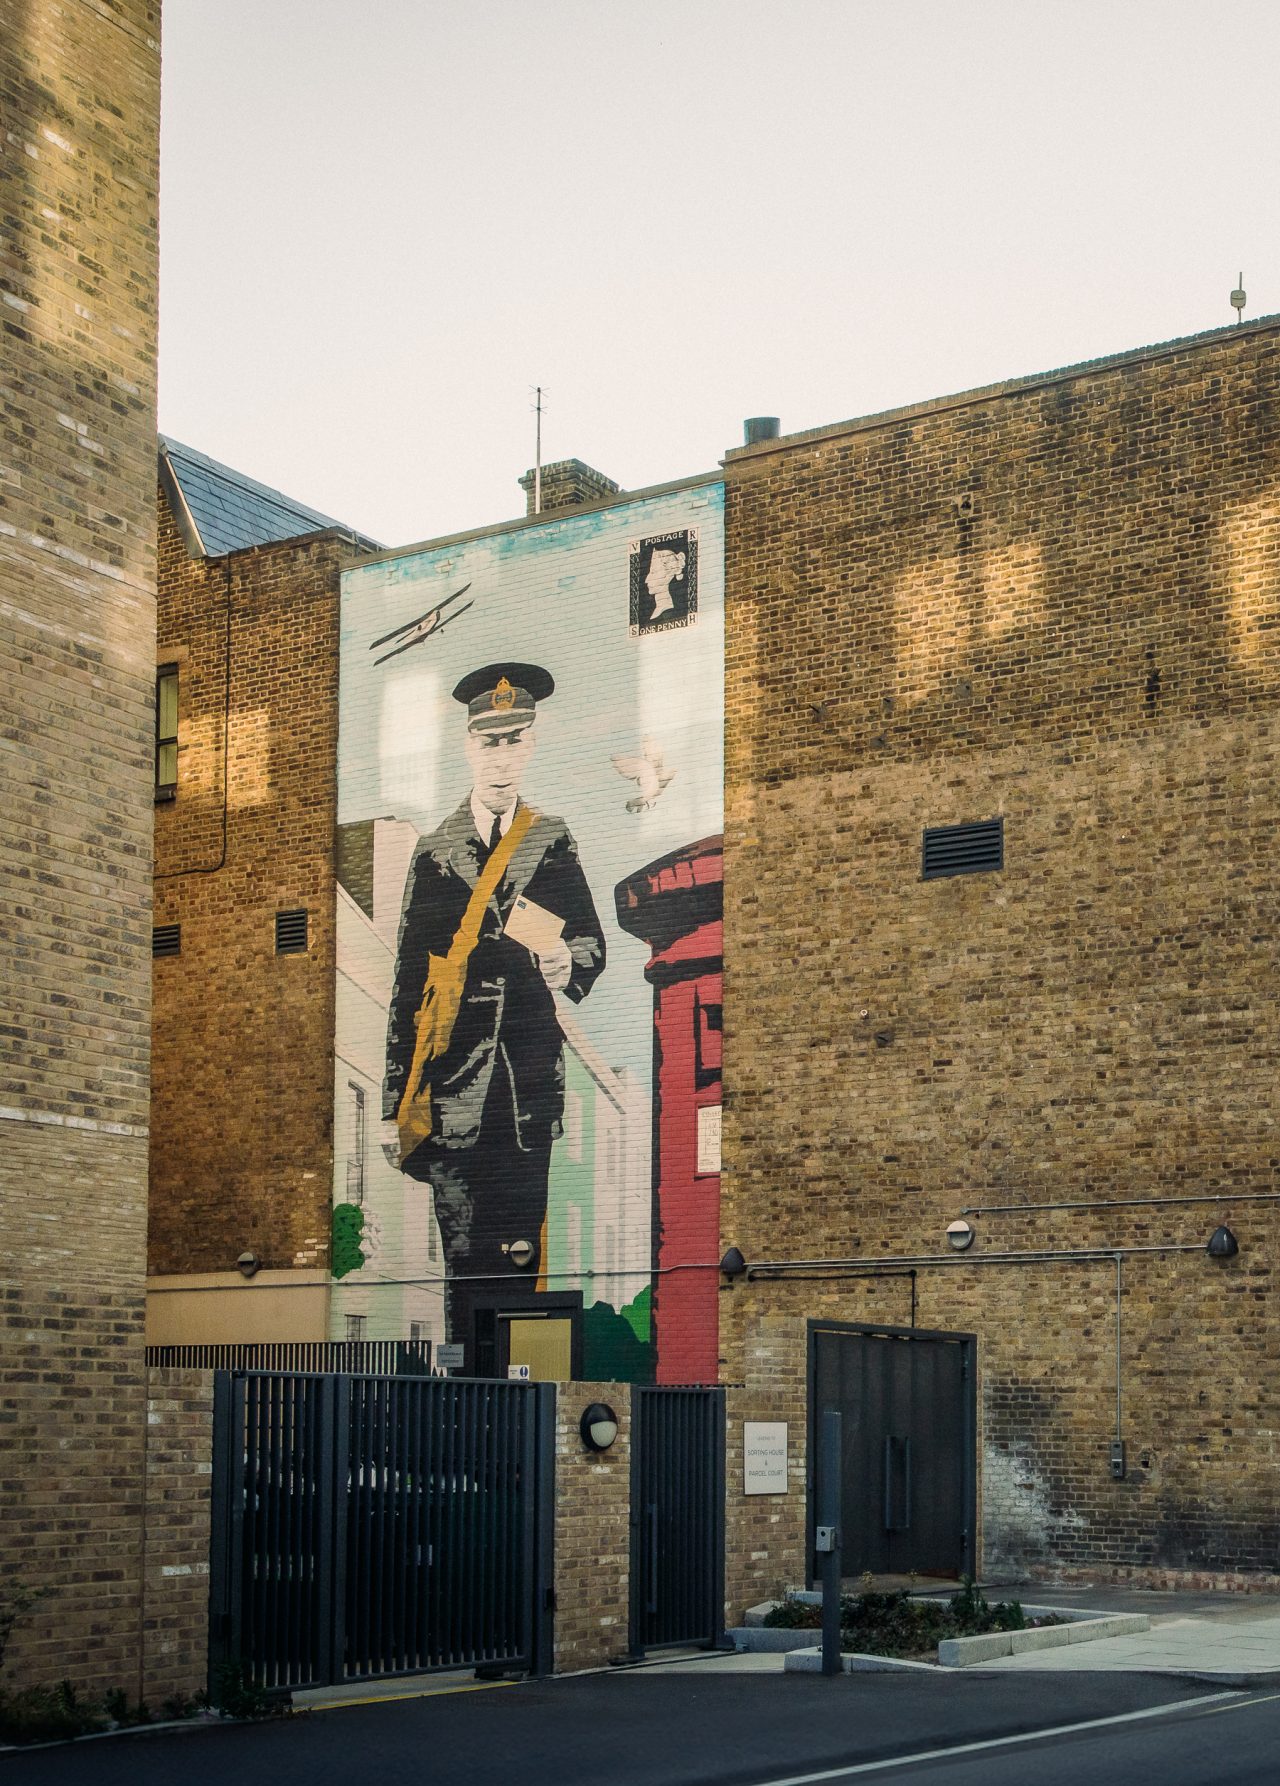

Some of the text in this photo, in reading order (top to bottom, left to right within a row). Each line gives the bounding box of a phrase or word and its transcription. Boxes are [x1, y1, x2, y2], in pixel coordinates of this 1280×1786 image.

[631, 530, 696, 551] V POSTAGE R
[631, 614, 696, 636] S ONE PENNY H
